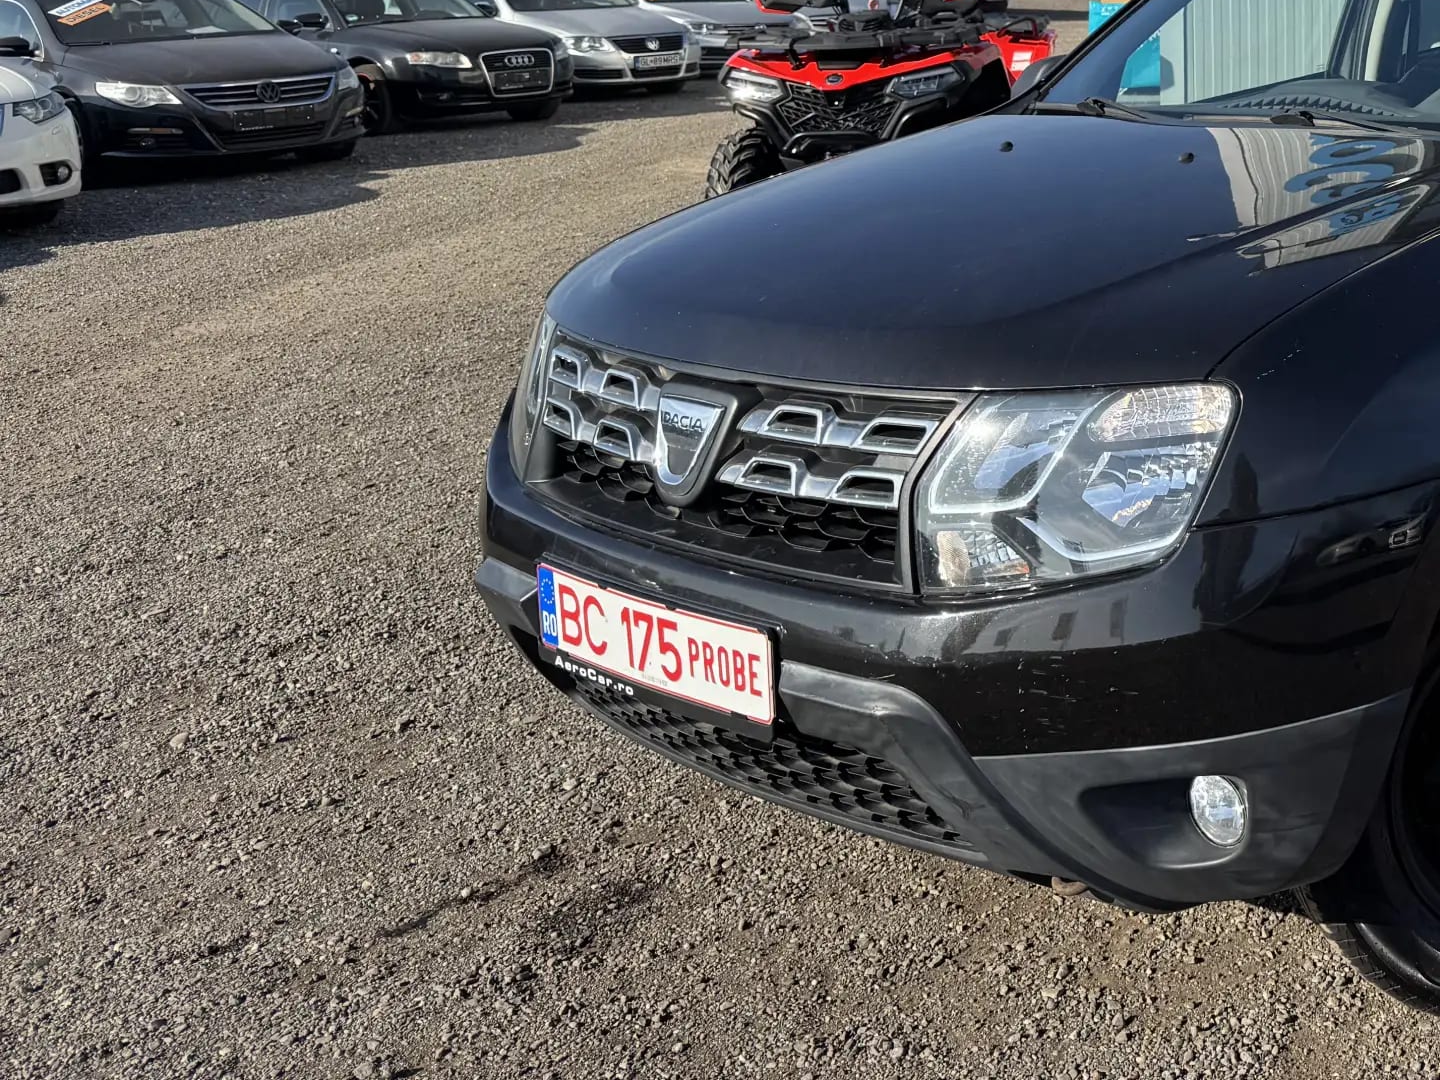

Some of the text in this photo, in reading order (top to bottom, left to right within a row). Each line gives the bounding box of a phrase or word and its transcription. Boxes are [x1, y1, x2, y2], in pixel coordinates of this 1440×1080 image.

[662, 411, 703, 432] DACIA
[543, 610, 558, 638] RO
[558, 583, 763, 698] BC 175 PROBE
[554, 655, 634, 696] AeroCar.ro
